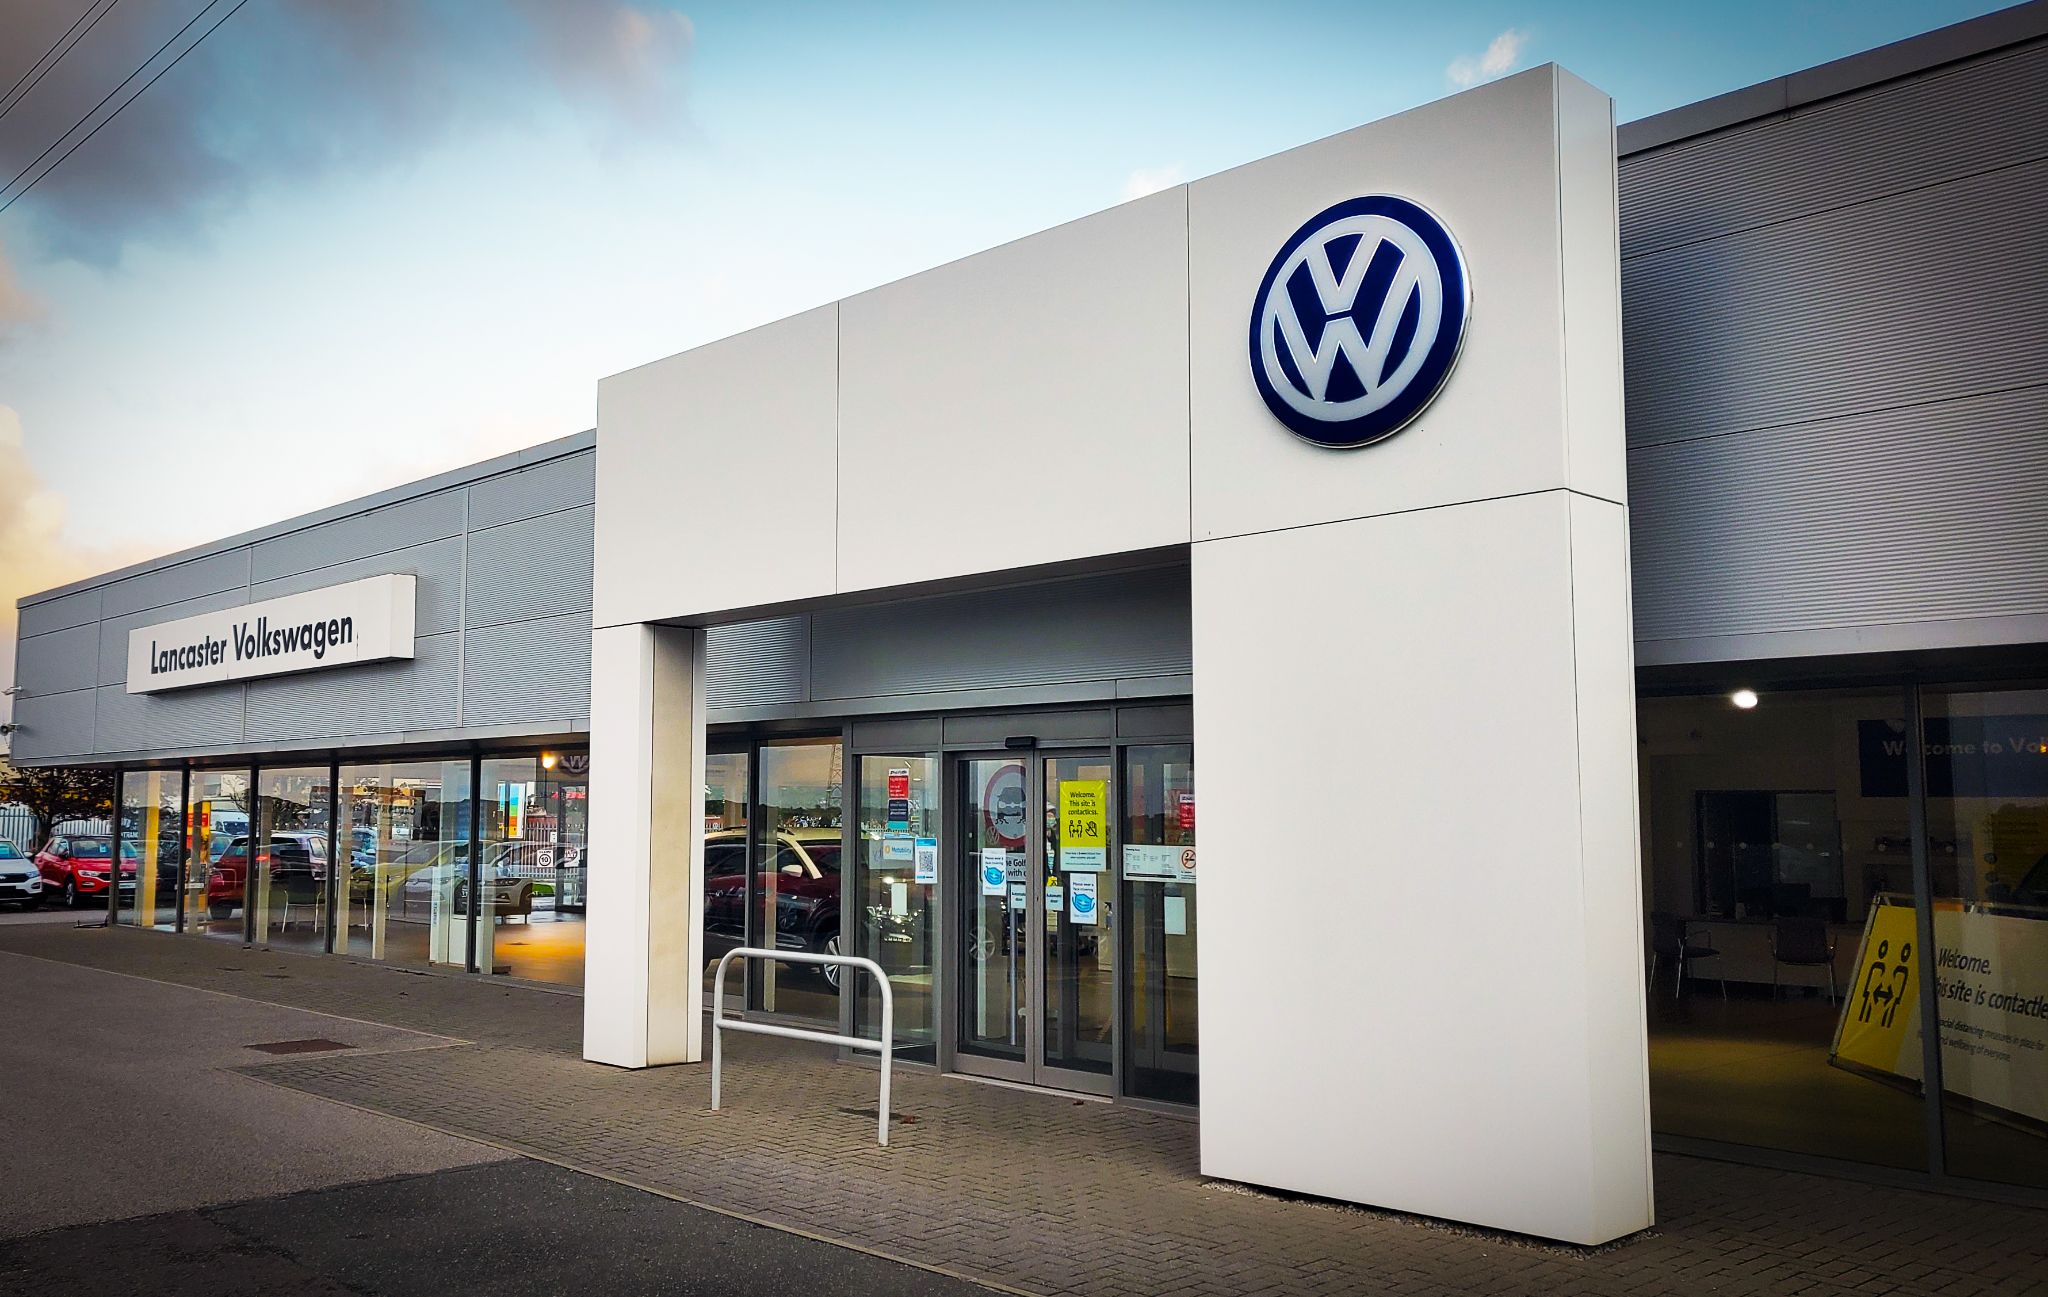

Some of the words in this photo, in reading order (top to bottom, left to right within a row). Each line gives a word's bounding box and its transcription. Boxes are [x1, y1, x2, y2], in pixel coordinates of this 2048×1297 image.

[150, 635, 227, 675] Lancaster
[232, 615, 353, 660] Volkswagen
[1881, 739, 1977, 757] Wcome
[1983, 740, 2003, 755] to
[1091, 799, 1096, 807] is
[1008, 868, 1022, 877] with
[1938, 947, 1992, 976] Welcome.
[1947, 979, 1973, 1003] site
[1975, 983, 1987, 1006] is
[1988, 992, 2048, 1020] contactle
